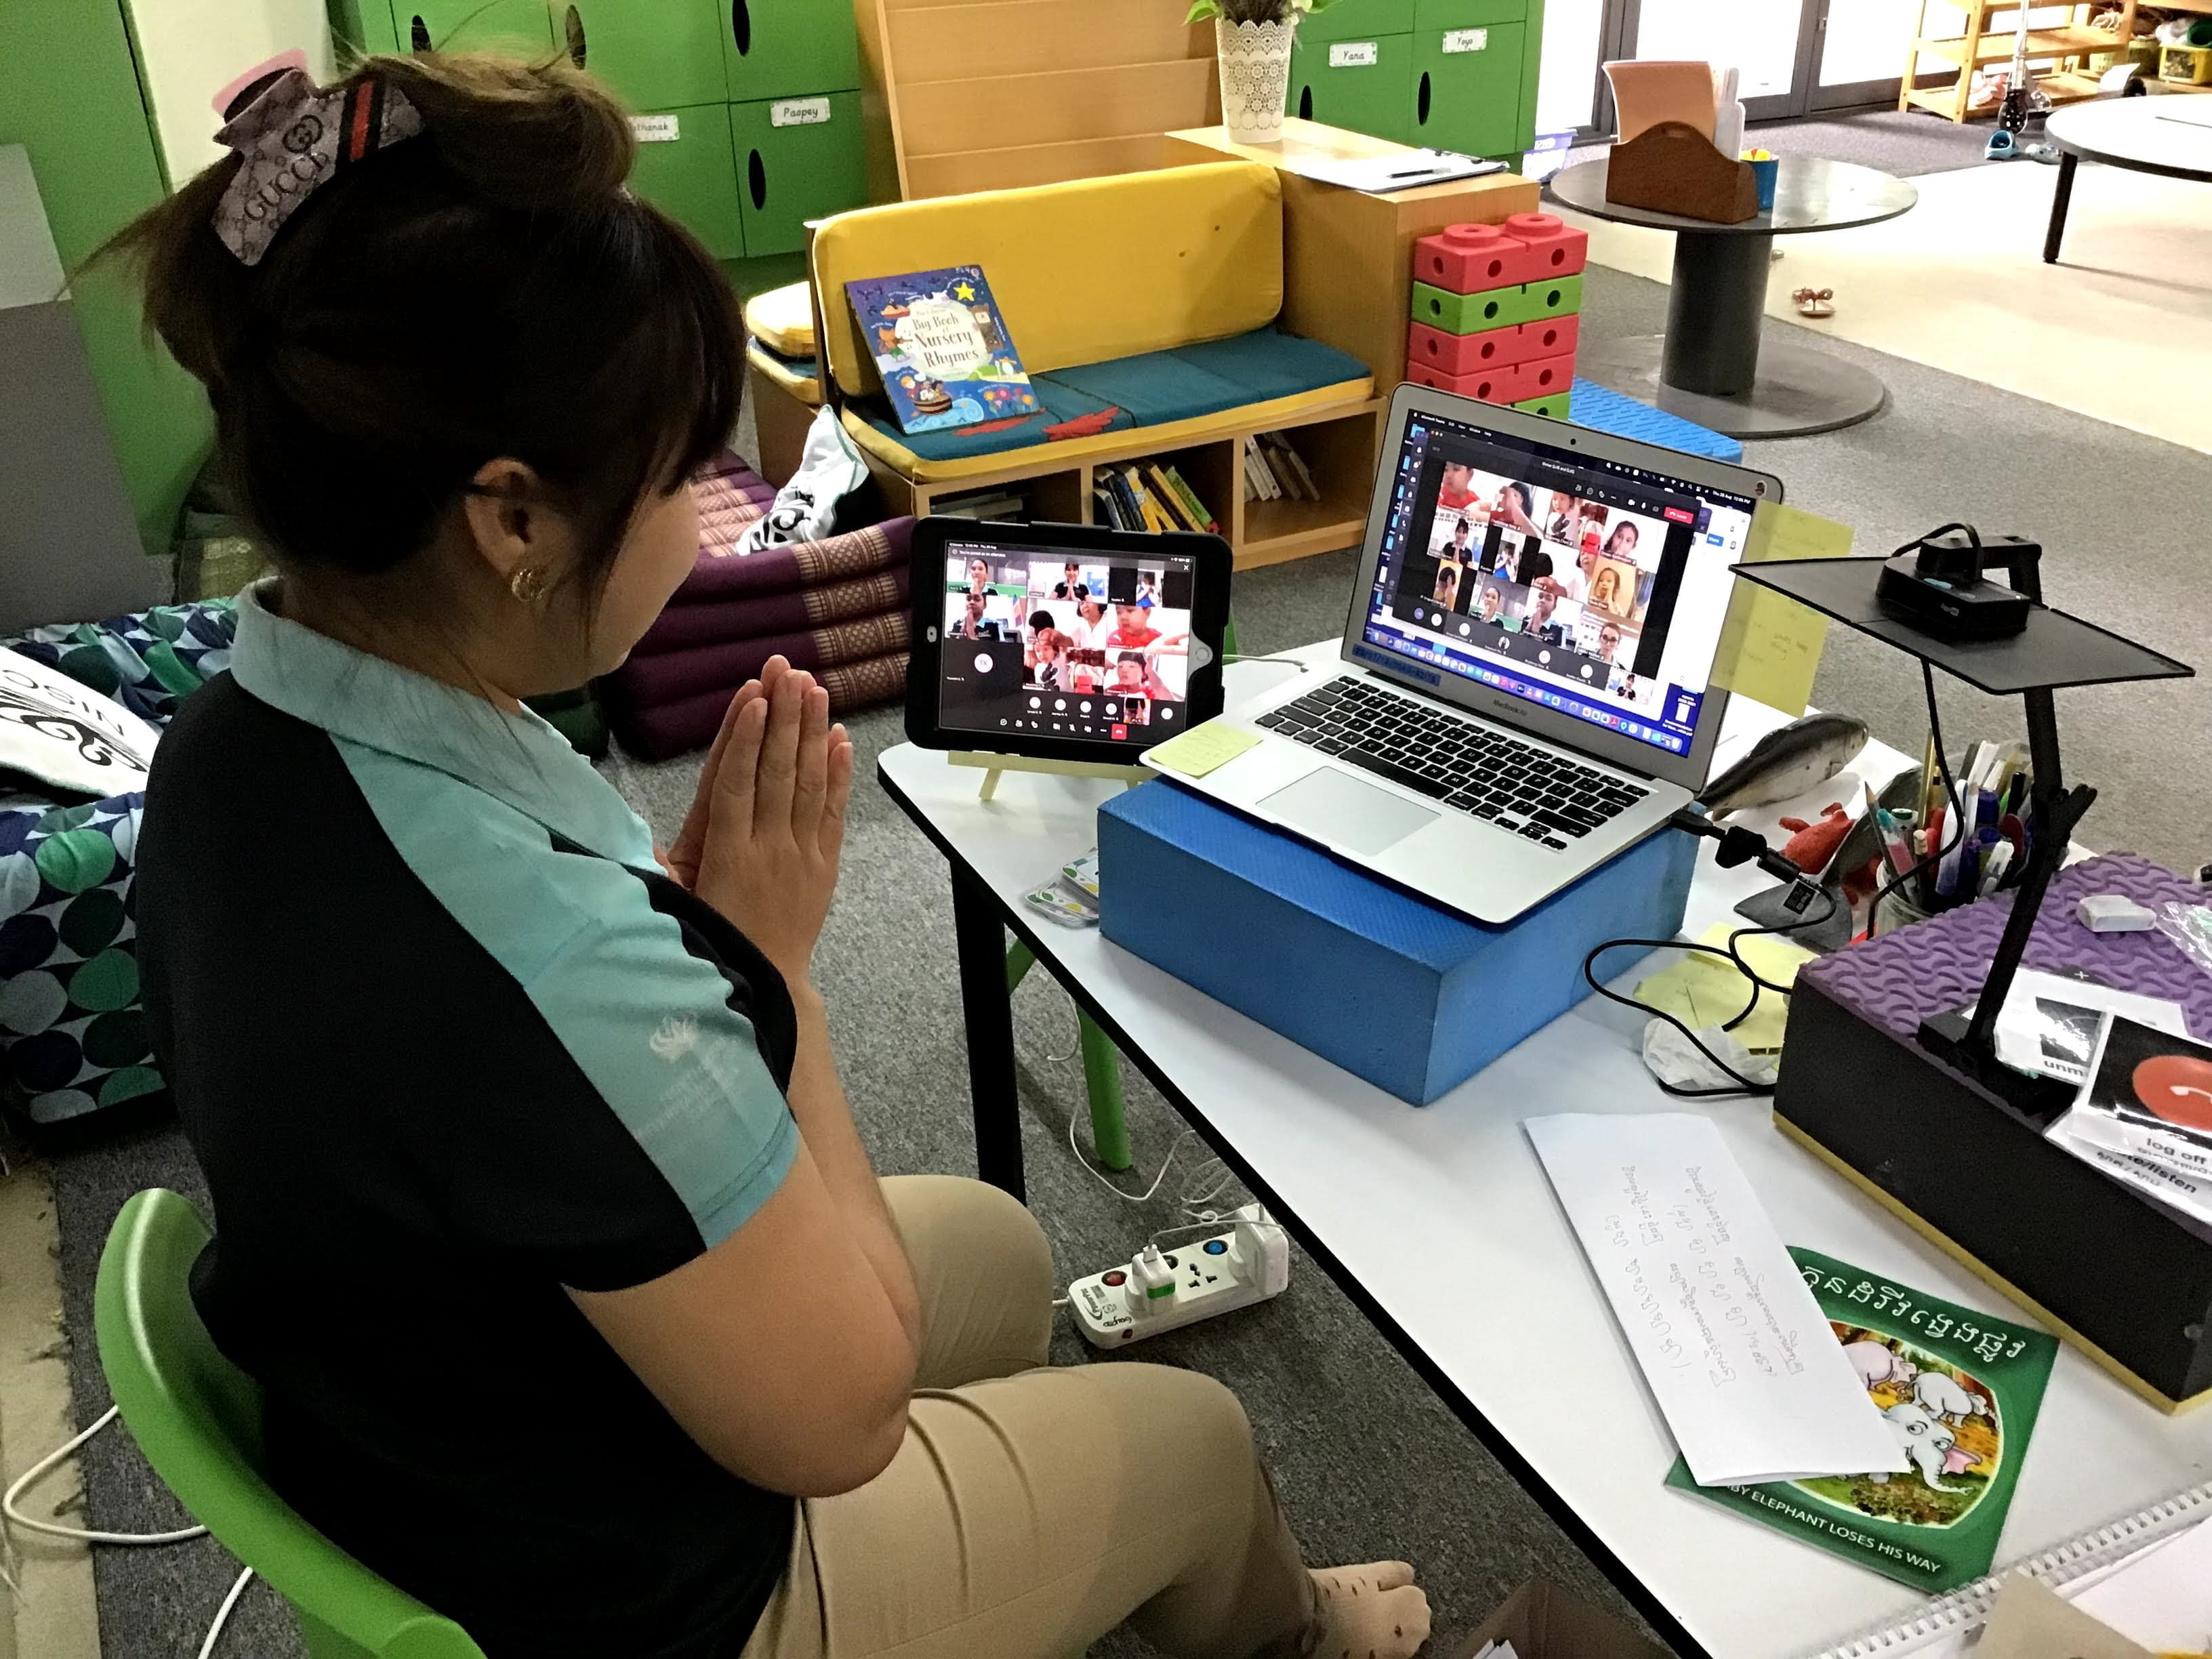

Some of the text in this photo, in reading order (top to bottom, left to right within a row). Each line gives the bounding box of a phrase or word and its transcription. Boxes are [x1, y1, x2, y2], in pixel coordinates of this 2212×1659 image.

[1457, 37, 1473, 48] Yoyo
[1343, 50, 1365, 60] Yana
[912, 312, 959, 331] Big Book
[915, 331, 974, 348] Nursery
[924, 350, 979, 367] Rhymes
[2044, 1060, 2089, 1078] unm
[2146, 1138, 2175, 1156] log
[2180, 1151, 2208, 1165] off
[1751, 1490, 1828, 1530] ELEPHANT
[1829, 1523, 1875, 1549] LOSES
[1878, 1542, 1903, 1559] HIS
[1906, 1552, 1942, 1573] WAY
